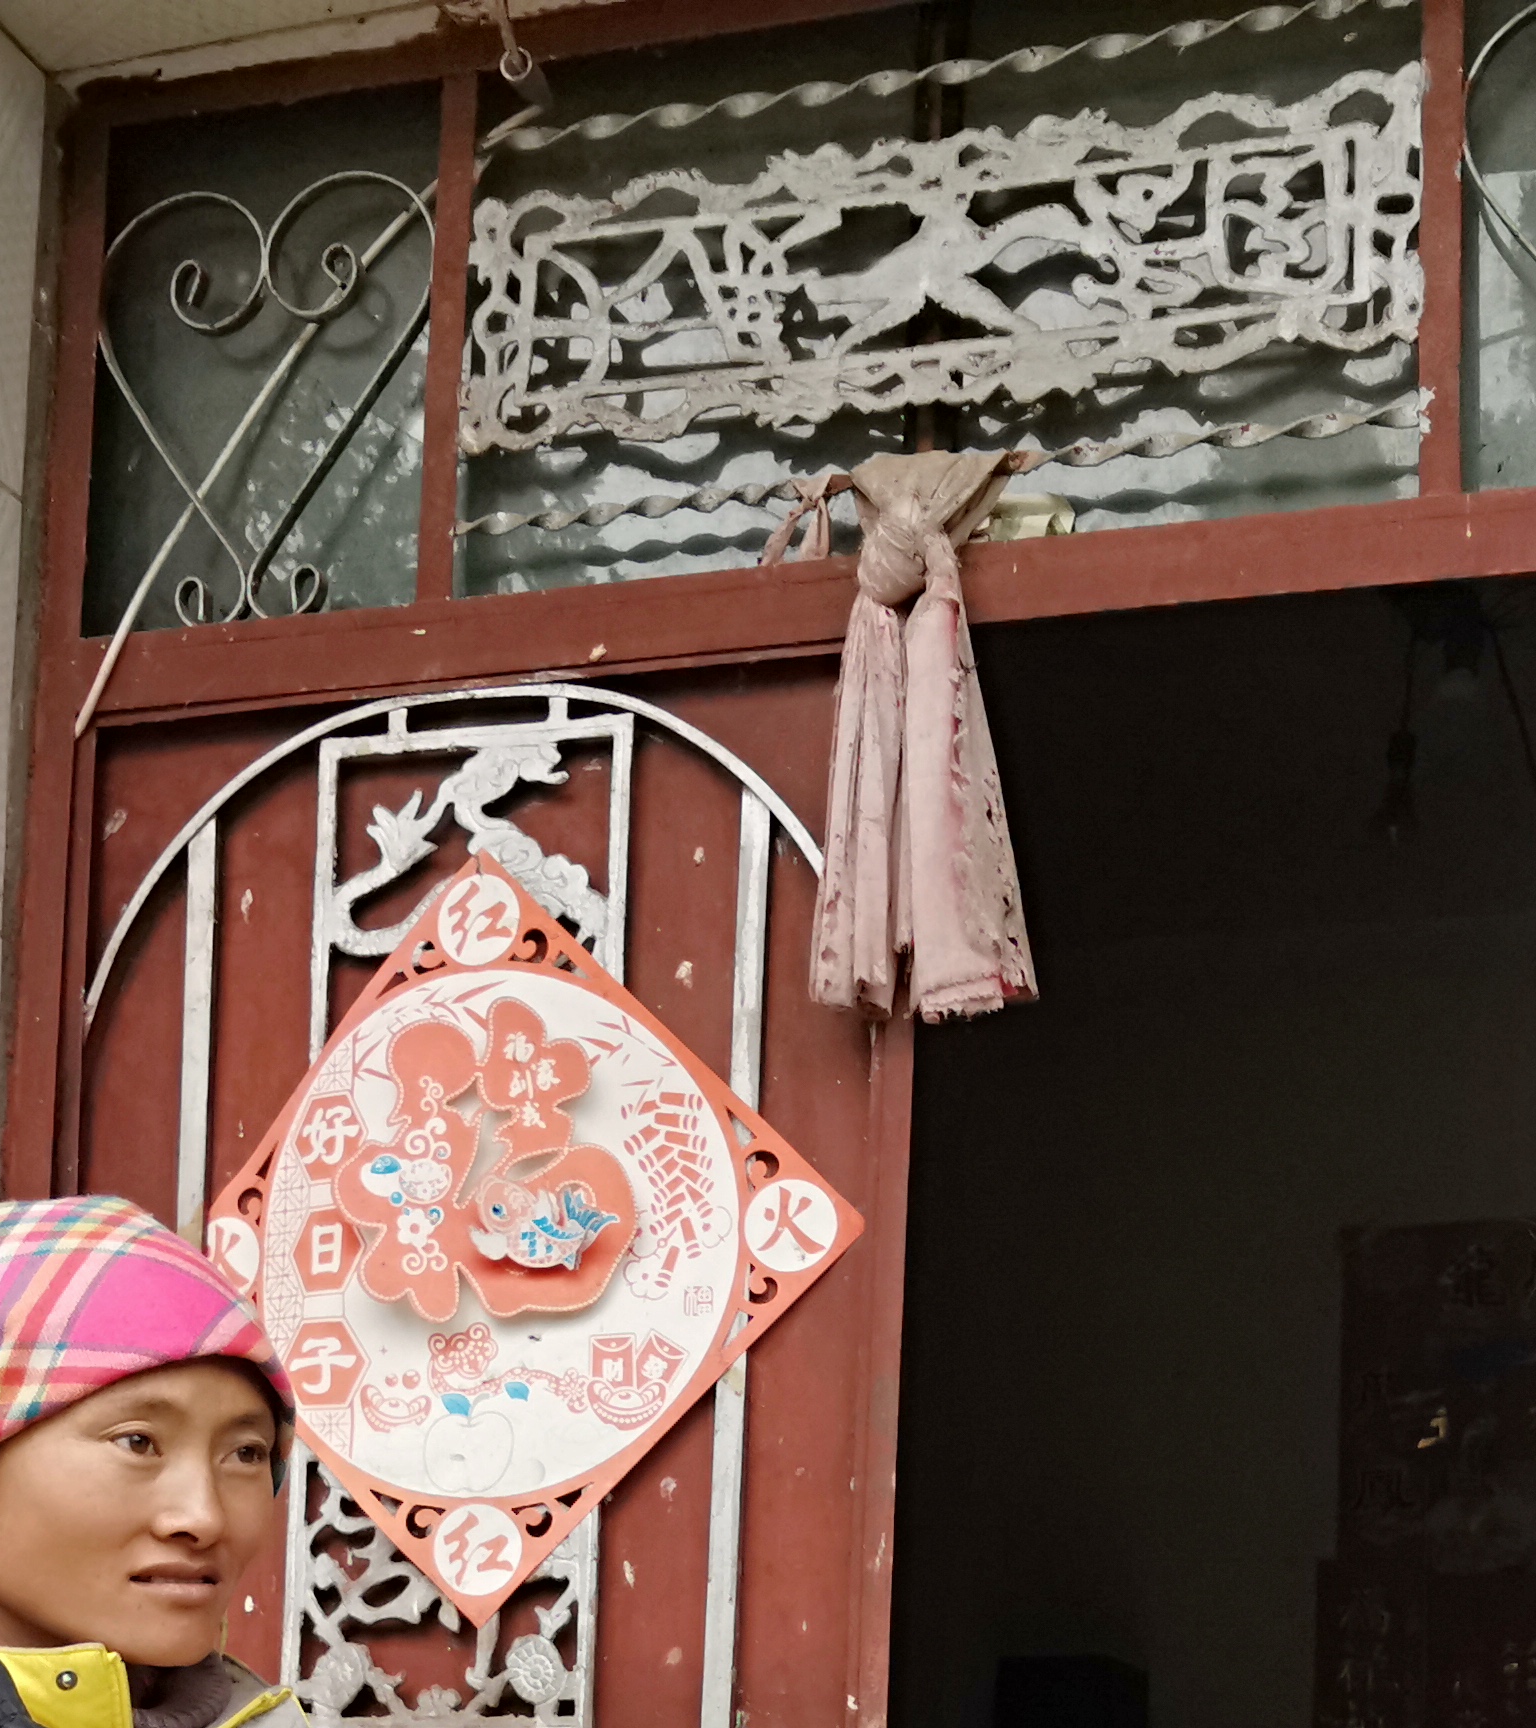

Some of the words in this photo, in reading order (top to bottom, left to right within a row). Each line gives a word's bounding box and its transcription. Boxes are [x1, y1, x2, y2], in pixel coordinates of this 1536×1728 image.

[446, 880, 515, 957] 红
[751, 1190, 827, 1256] 火
[445, 1511, 515, 1587] 红
